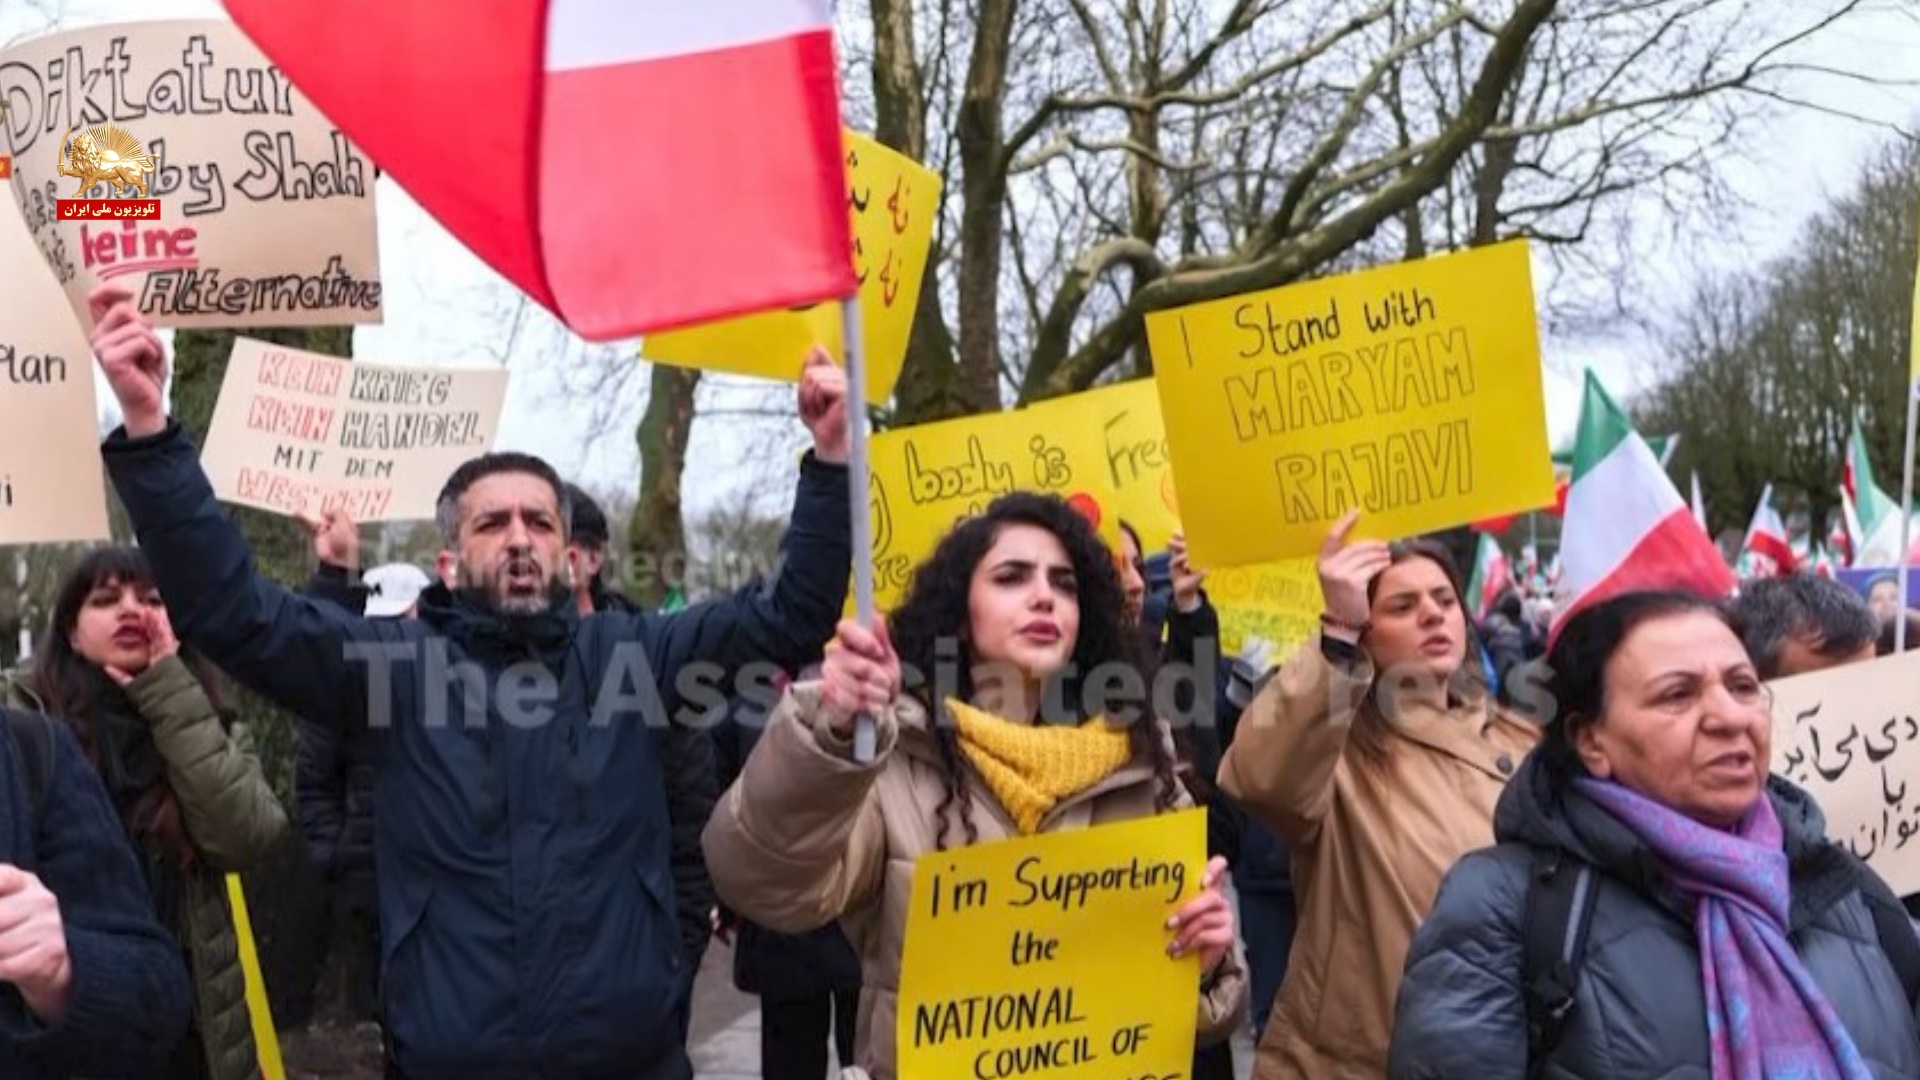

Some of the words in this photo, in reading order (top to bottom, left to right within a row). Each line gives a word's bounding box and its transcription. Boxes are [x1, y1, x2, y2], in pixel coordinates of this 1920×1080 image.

[0, 35, 294, 158] Diktatur
[234, 129, 366, 201] Shah
[80, 221, 198, 268] keine
[139, 256, 383, 314] Alternative
[1179, 314, 1194, 368] I
[1233, 297, 1341, 359] Stand
[258, 351, 342, 398] KEIN
[350, 366, 452, 405] KRIEG
[1223, 326, 1477, 443] MARYAM
[247, 395, 335, 443] KEIN
[340, 410, 485, 450] HANDEL
[274, 445, 323, 471] MIT
[345, 458, 395, 479] DEM
[905, 435, 1016, 505] body
[1029, 434, 1073, 488] is
[1274, 418, 1475, 524] RAJAVI
[931, 863, 988, 918] I'm
[1008, 856, 1187, 911] Supporting
[1011, 930, 1059, 966] the
[914, 986, 1087, 1048] NATIONAL
[974, 1036, 1097, 1080] COUNCIL
[1111, 1023, 1153, 1057] OF
